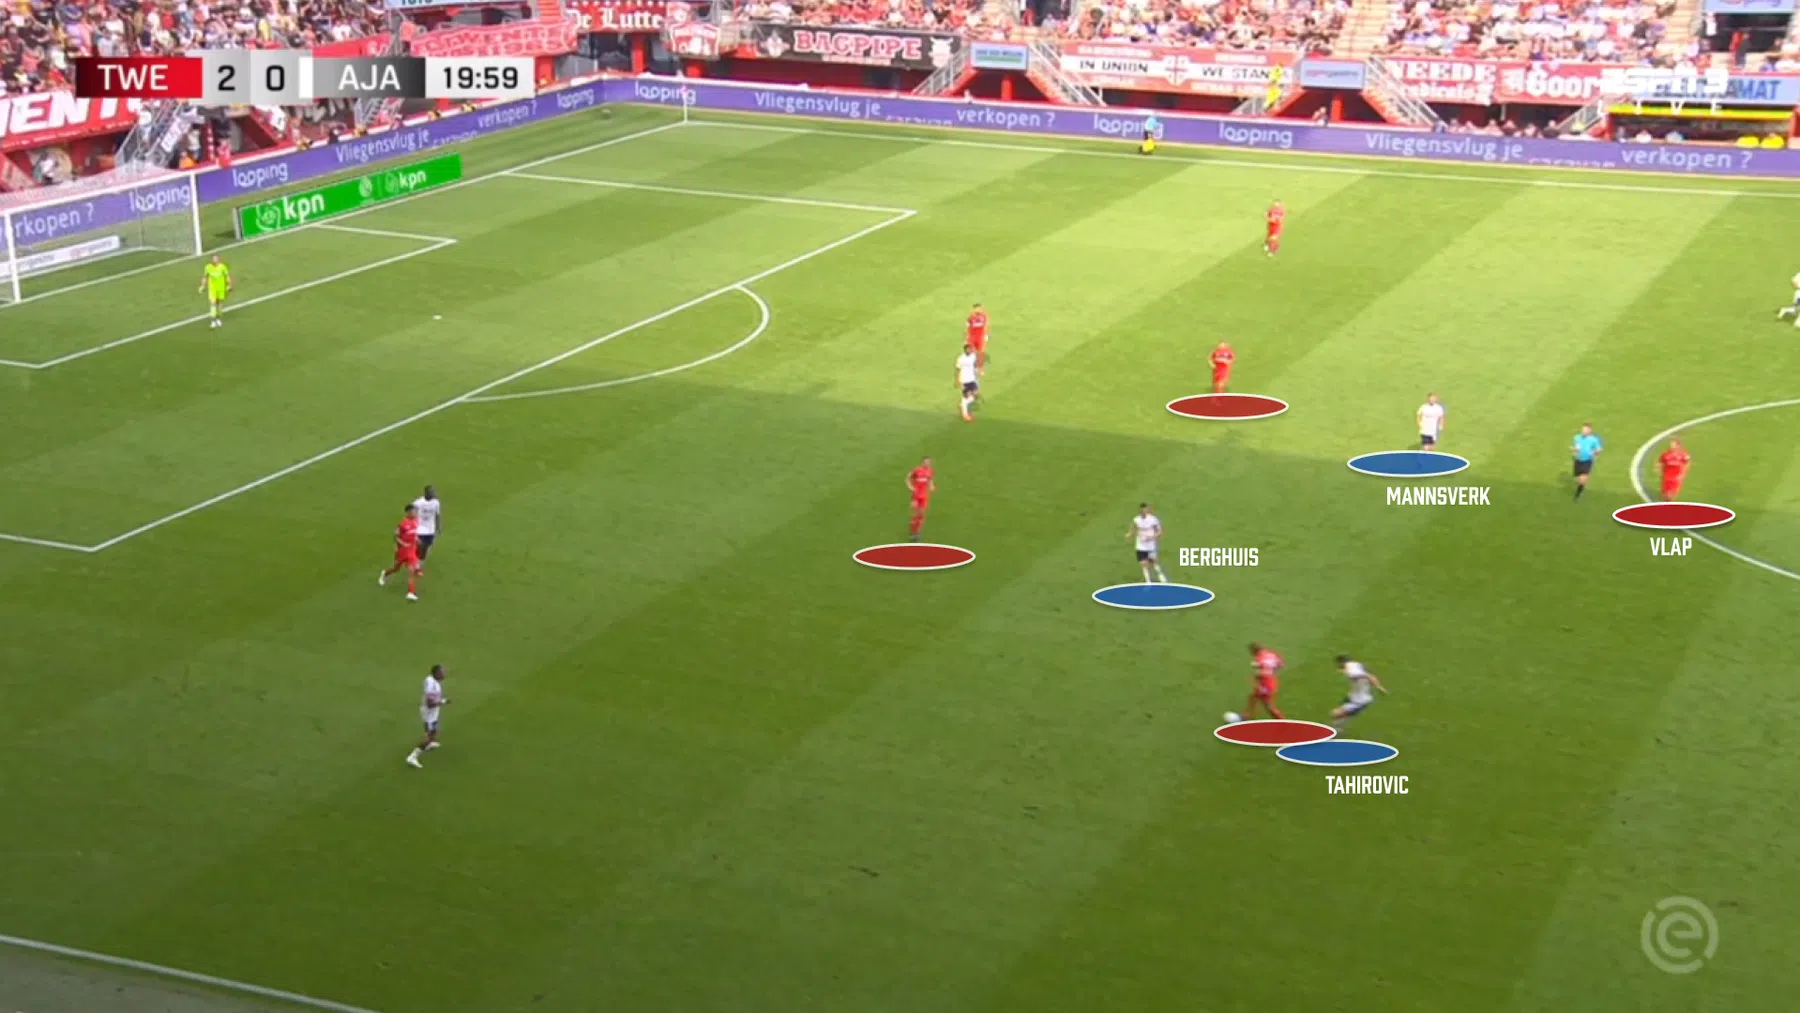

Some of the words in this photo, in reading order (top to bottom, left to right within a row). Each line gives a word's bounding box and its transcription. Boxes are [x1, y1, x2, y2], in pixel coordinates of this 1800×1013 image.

[600, 8, 664, 29] Lutte
[793, 30, 922, 60] BAGPIPE
[478, 106, 528, 128] verkopen
[754, 91, 861, 117] Vliegensvlug
[863, 99, 881, 117] je
[957, 109, 1040, 128] verkopen
[335, 133, 416, 163] Vliegensvlug
[1219, 122, 1293, 149] looping
[1366, 133, 1497, 160] Vliegensvlug
[1501, 140, 1523, 161] je
[1622, 147, 1732, 170] verkopen
[232, 163, 288, 190] looping
[400, 170, 427, 191] kpn
[284, 192, 325, 223] kpn
